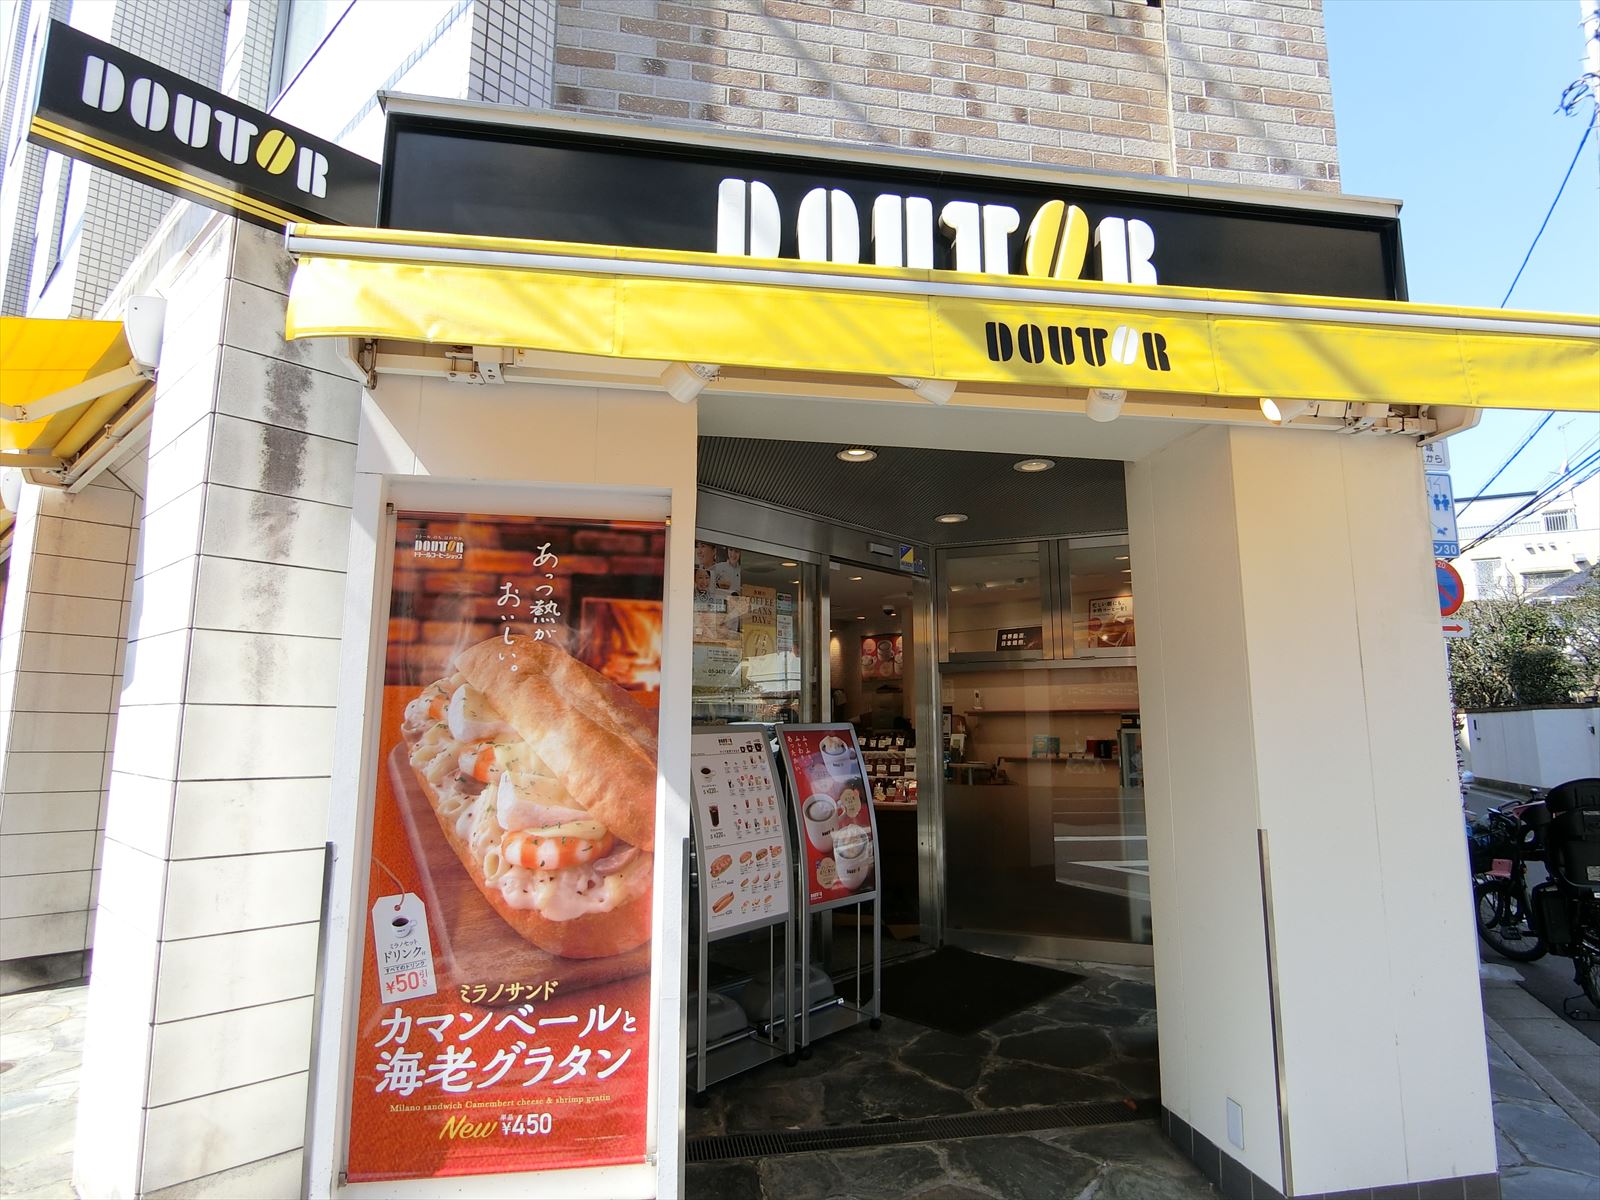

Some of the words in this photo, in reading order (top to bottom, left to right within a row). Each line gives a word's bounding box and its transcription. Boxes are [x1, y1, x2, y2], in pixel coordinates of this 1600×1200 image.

[81, 54, 329, 199] DOUTOR
[716, 177, 1158, 285] DOUTOR
[985, 321, 1171, 371] DOUTOR
[1424, 454, 1443, 463] から
[414, 540, 464, 554] DOUTOR
[459, 980, 559, 1004] ミラノサンド
[374, 1003, 637, 1048] カマンベールと
[375, 1040, 632, 1097] 海老グラタン
[389, 1104, 421, 1113] Milano
[423, 1101, 463, 1112] sandwich
[465, 1099, 515, 1109] Camembert
[516, 1098, 544, 1107] cheese
[555, 1096, 584, 1107] shrimp
[586, 1094, 611, 1105] gratin
[439, 1115, 498, 1140] New
[501, 1113, 553, 1136] ¥450
